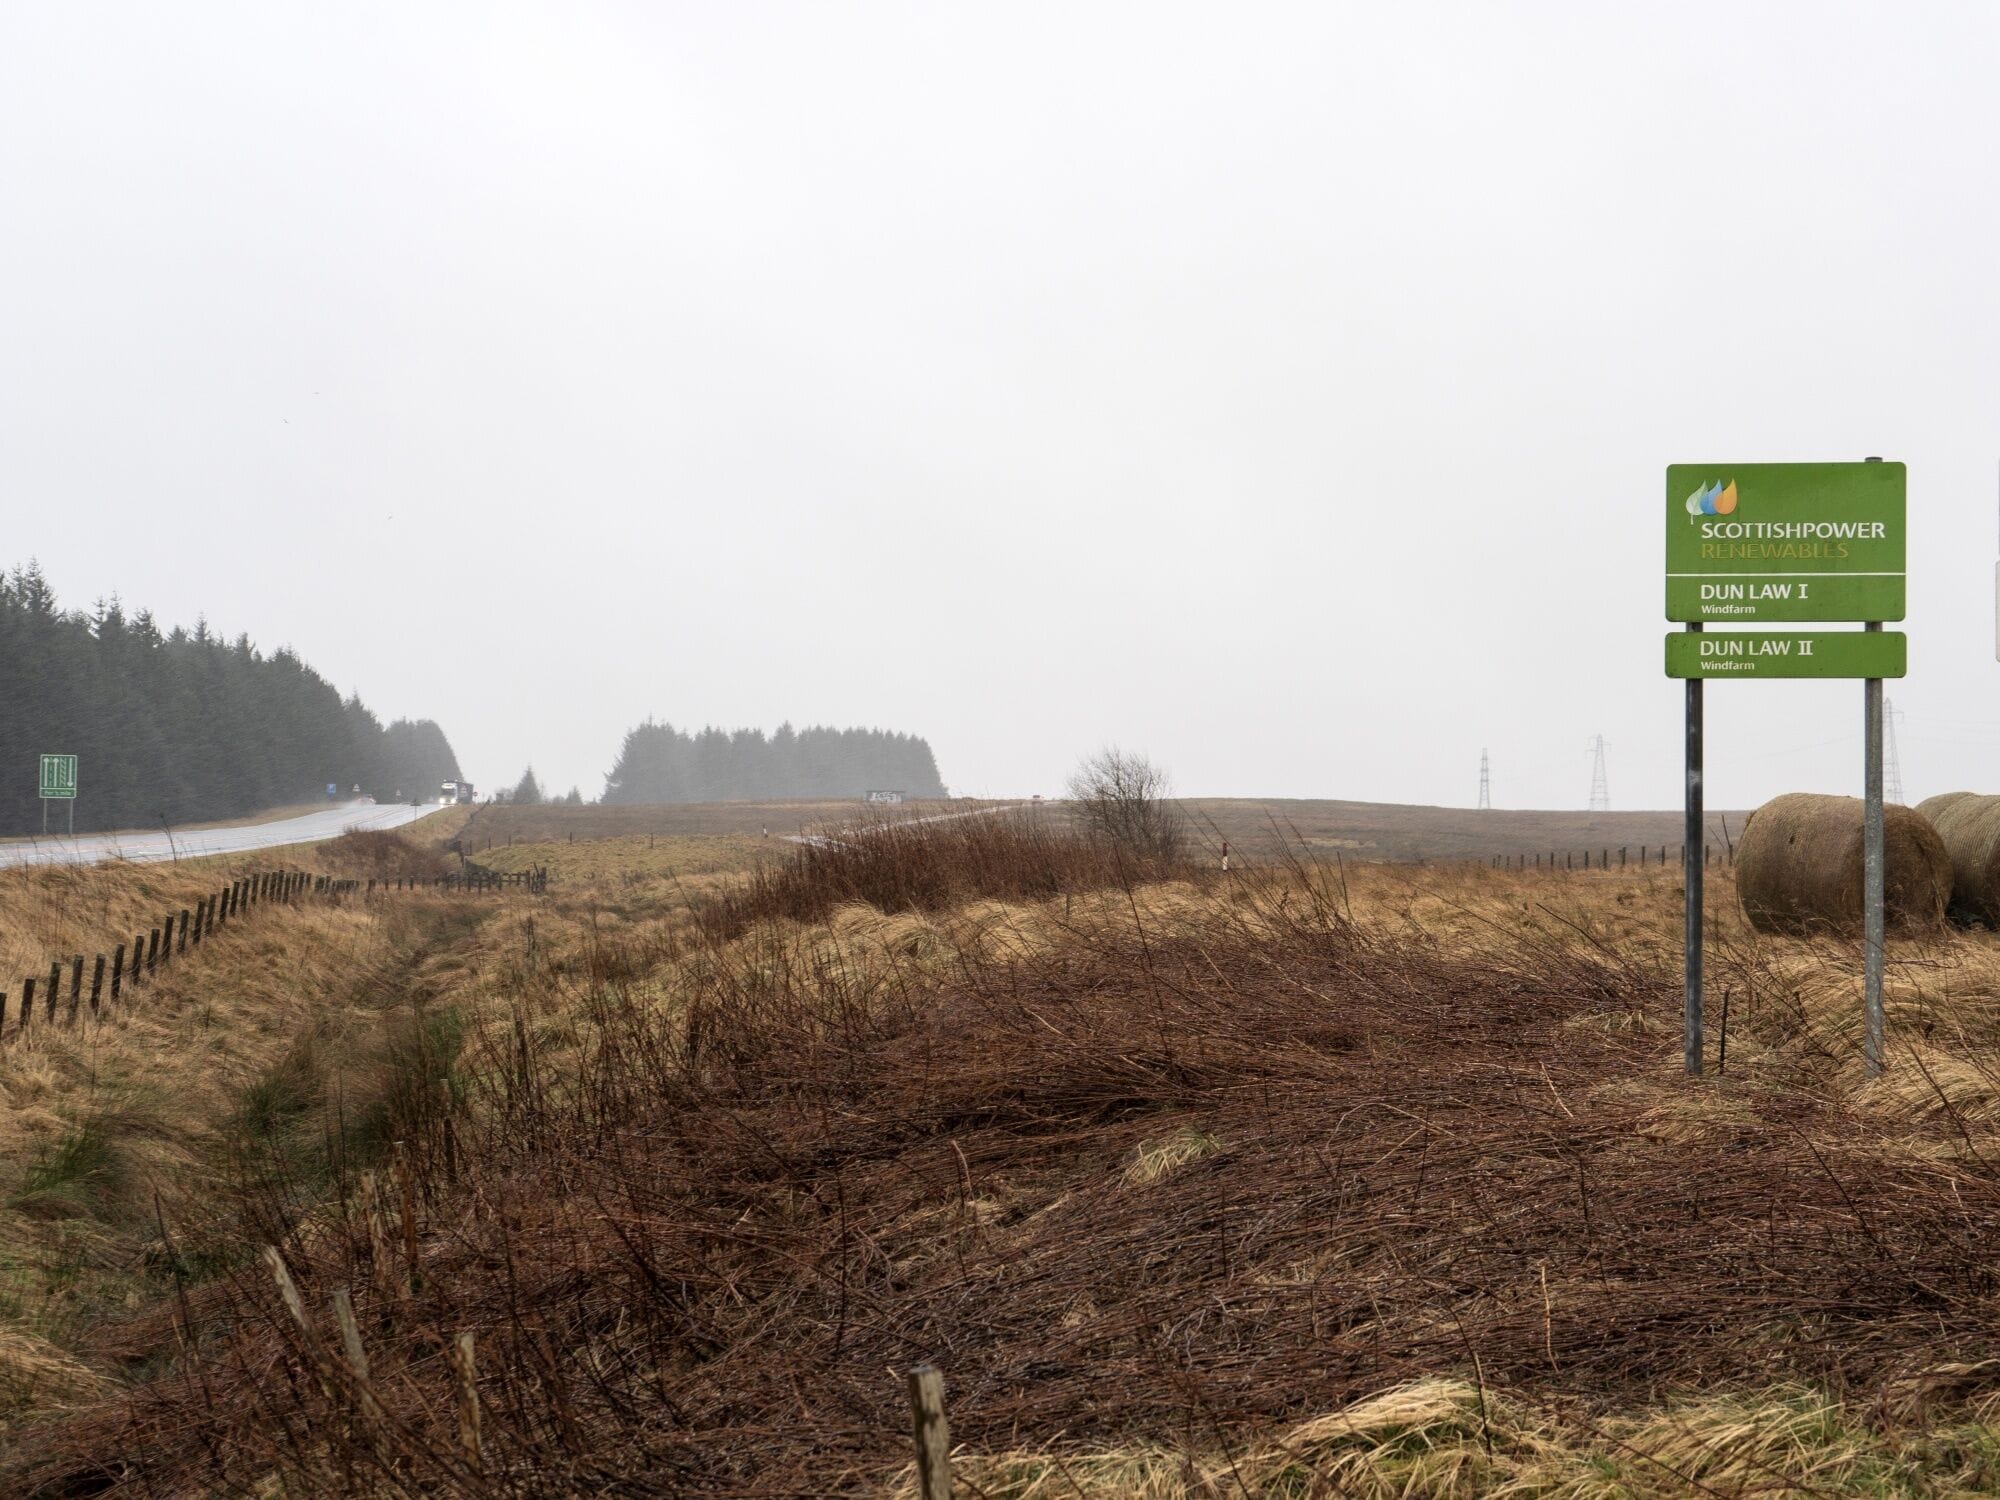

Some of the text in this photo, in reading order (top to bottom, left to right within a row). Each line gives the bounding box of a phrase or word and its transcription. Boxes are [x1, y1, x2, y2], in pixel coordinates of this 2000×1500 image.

[1701, 522, 1886, 539] SCOTTISHPOWER
[1701, 543, 1848, 560] RENEWABLES
[1701, 583, 1809, 600] DUN LAW I
[1701, 605, 1756, 614] Windfarm
[1700, 640, 1814, 656] DUN LAW II
[1701, 660, 1755, 671] Windfarm
